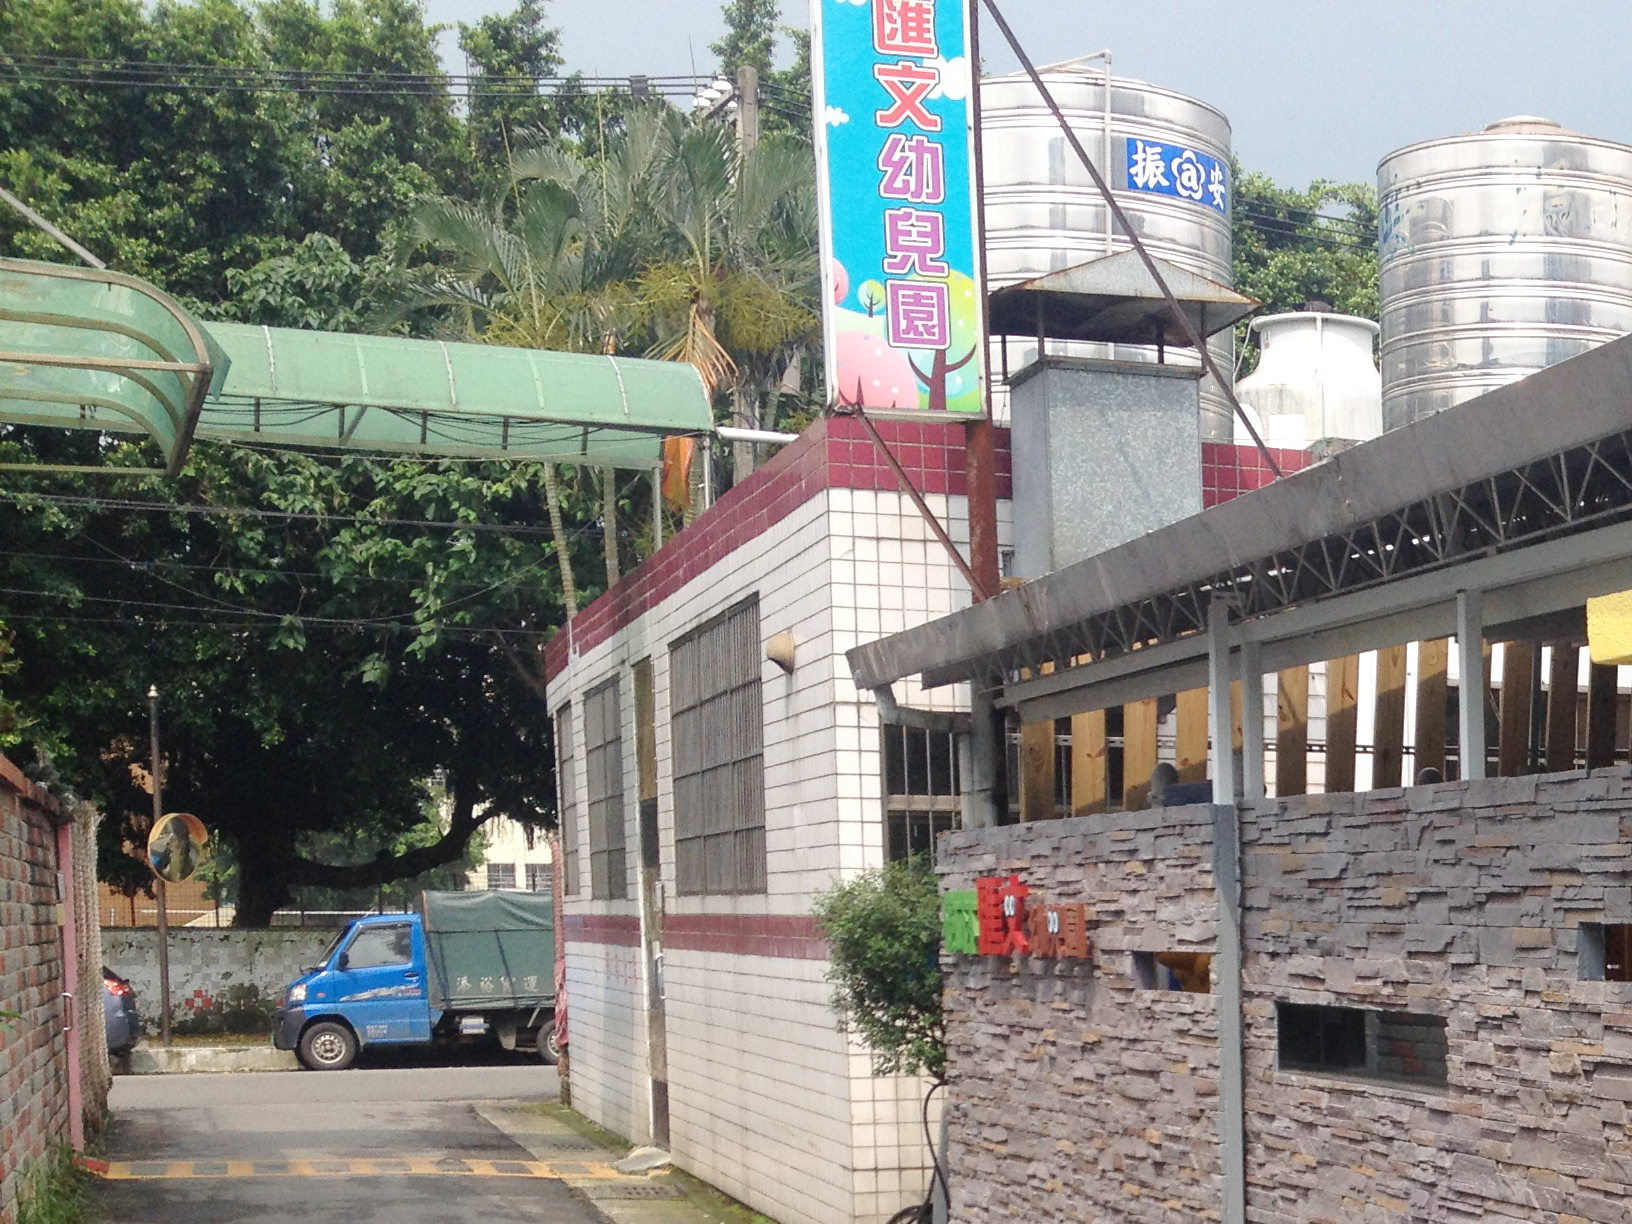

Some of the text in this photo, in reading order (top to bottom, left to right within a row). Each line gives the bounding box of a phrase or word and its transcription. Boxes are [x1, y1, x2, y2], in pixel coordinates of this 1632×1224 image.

[872, 0, 951, 350] 匯文幼兒園
